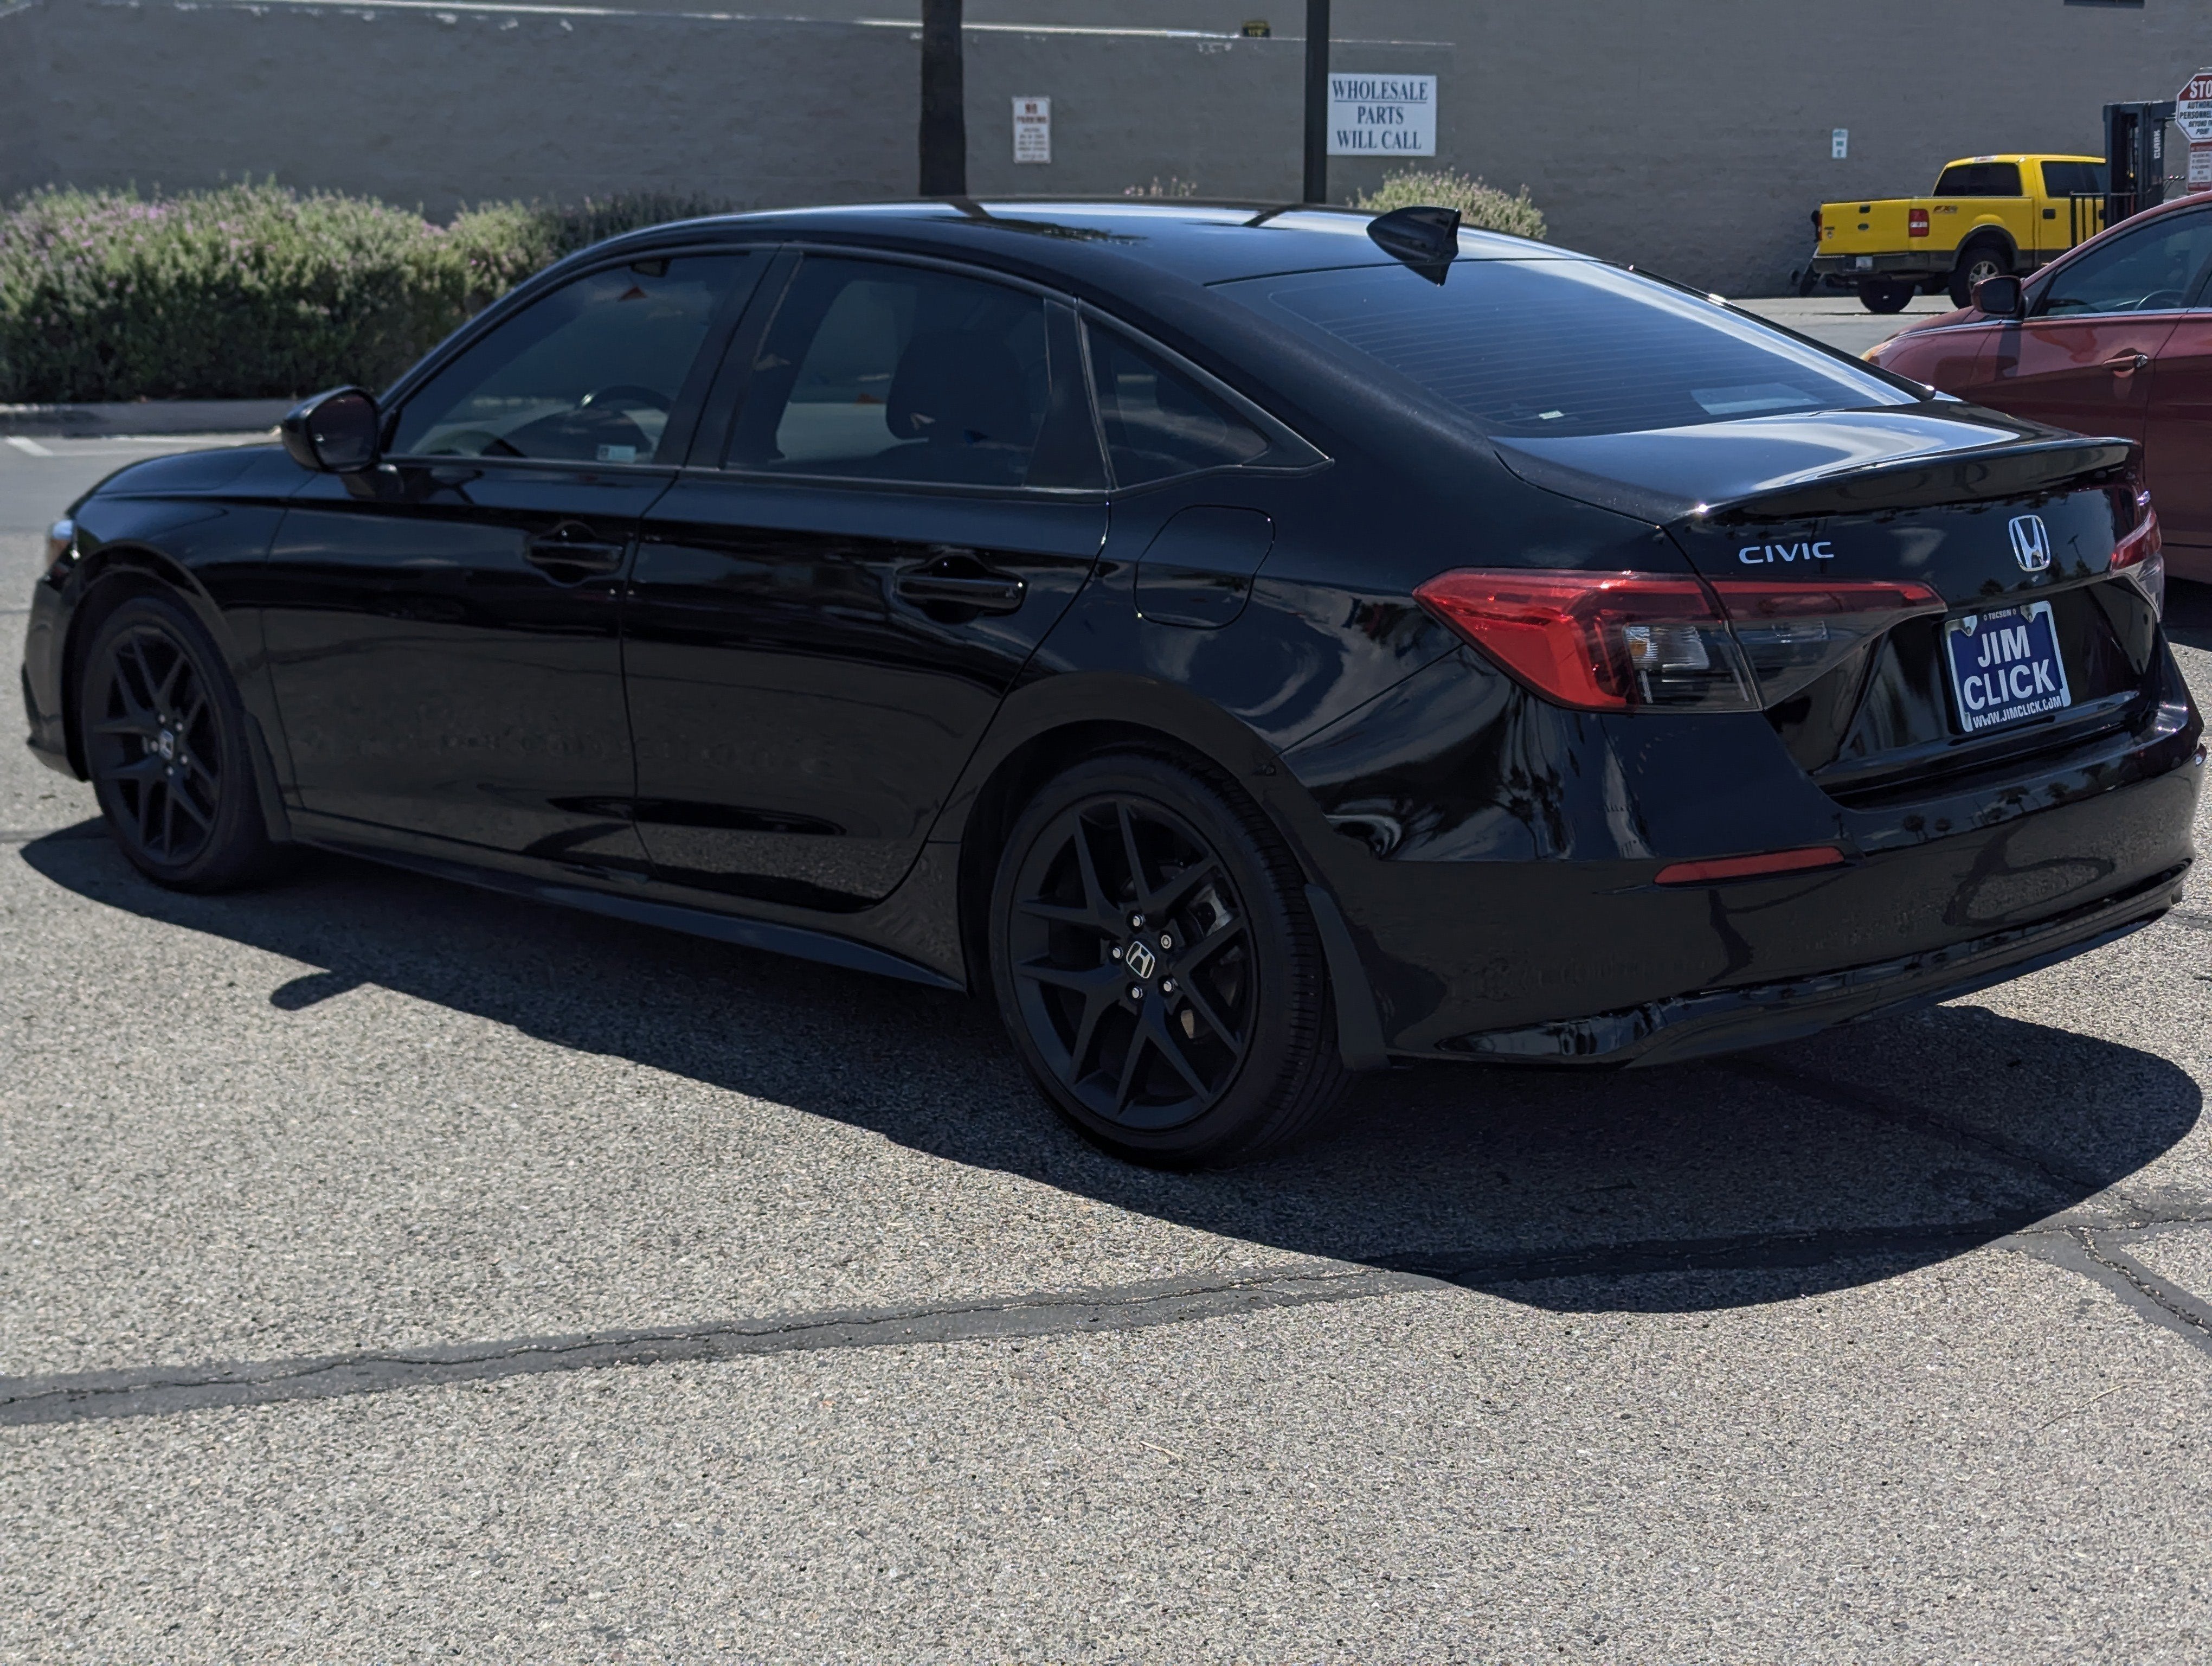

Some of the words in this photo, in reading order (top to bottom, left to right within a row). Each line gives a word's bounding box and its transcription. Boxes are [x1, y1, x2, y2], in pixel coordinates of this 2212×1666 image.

[1332, 80, 1428, 100] WHOLESALE
[1358, 106, 1404, 125] PARTS
[1336, 130, 1377, 149] WILL
[1381, 130, 1422, 150] CALL
[1739, 541, 1835, 564] CIVIC
[1977, 625, 2031, 668] JIM
[1964, 658, 2056, 710] CLICK
